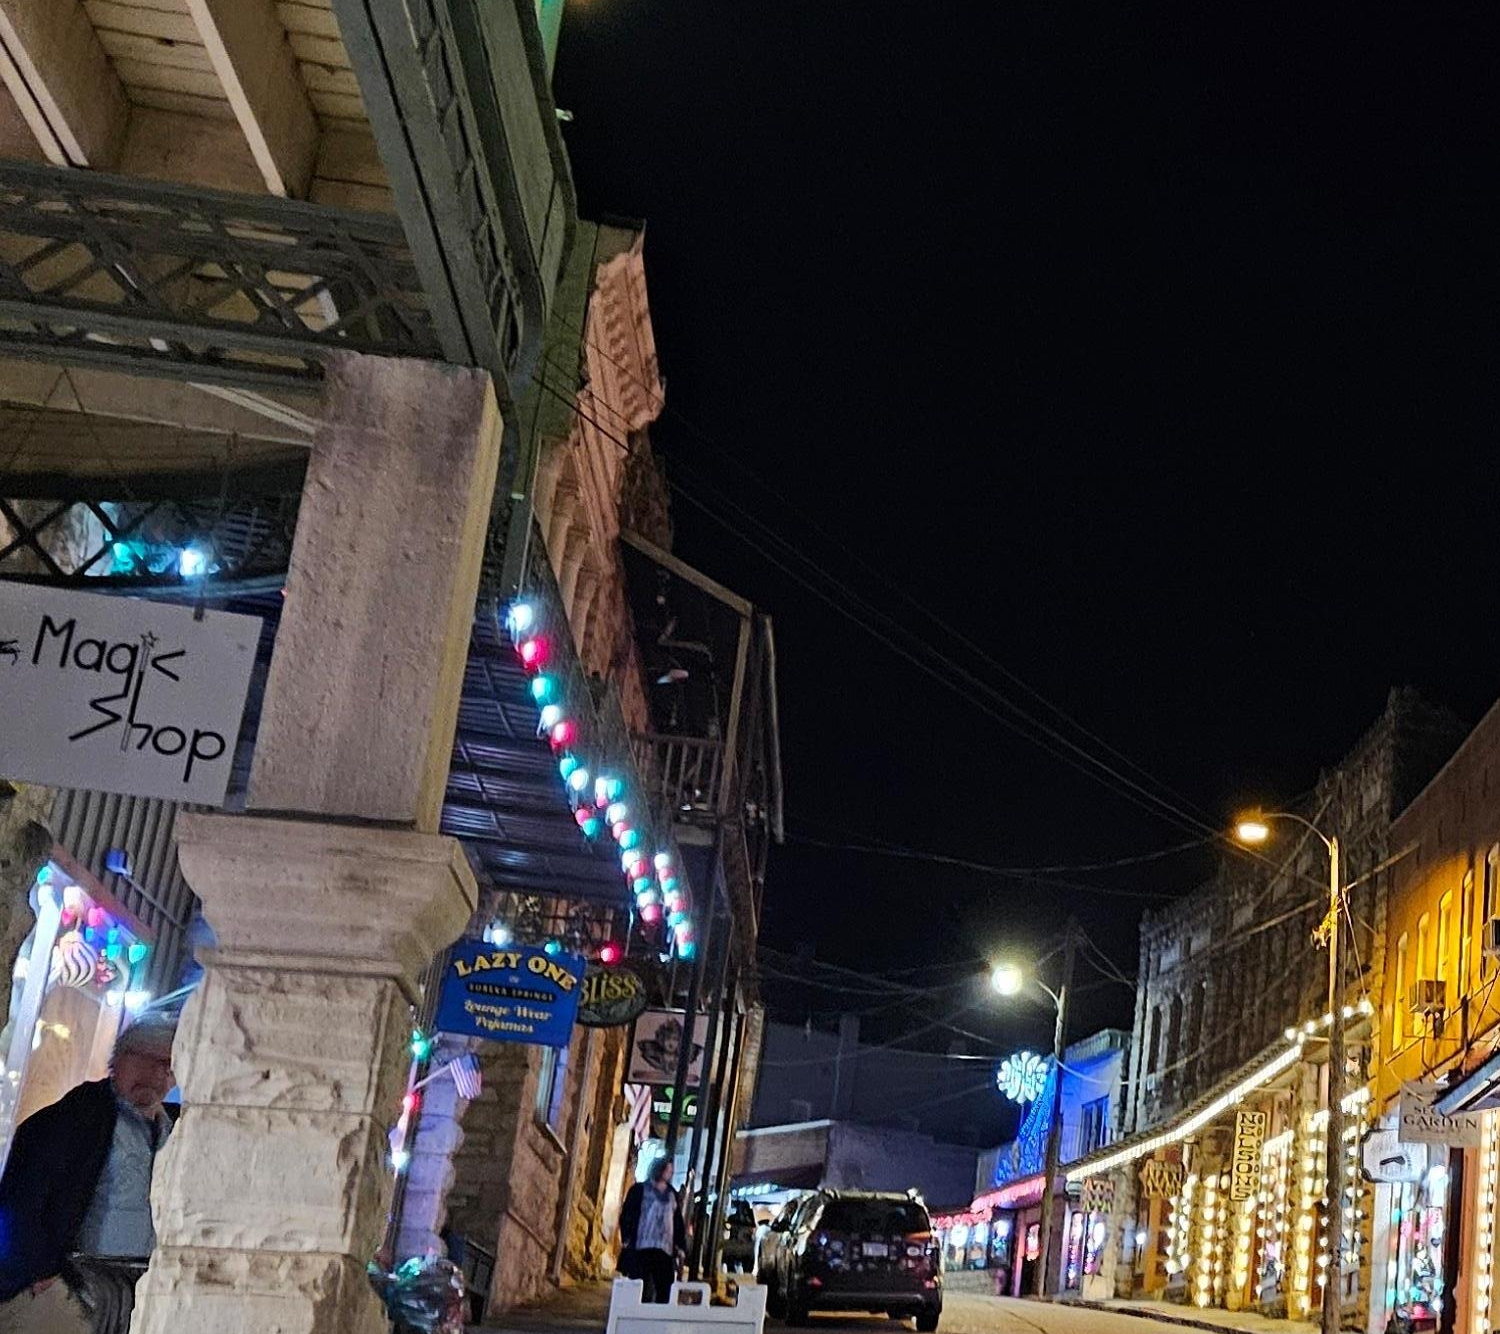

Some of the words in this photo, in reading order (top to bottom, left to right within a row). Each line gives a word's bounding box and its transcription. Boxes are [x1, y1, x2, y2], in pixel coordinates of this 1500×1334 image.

[69, 671, 226, 783] Shop
[454, 952, 523, 977] LAZY
[528, 956, 577, 991] ONE
[1403, 1113, 1478, 1129] GARDEN
